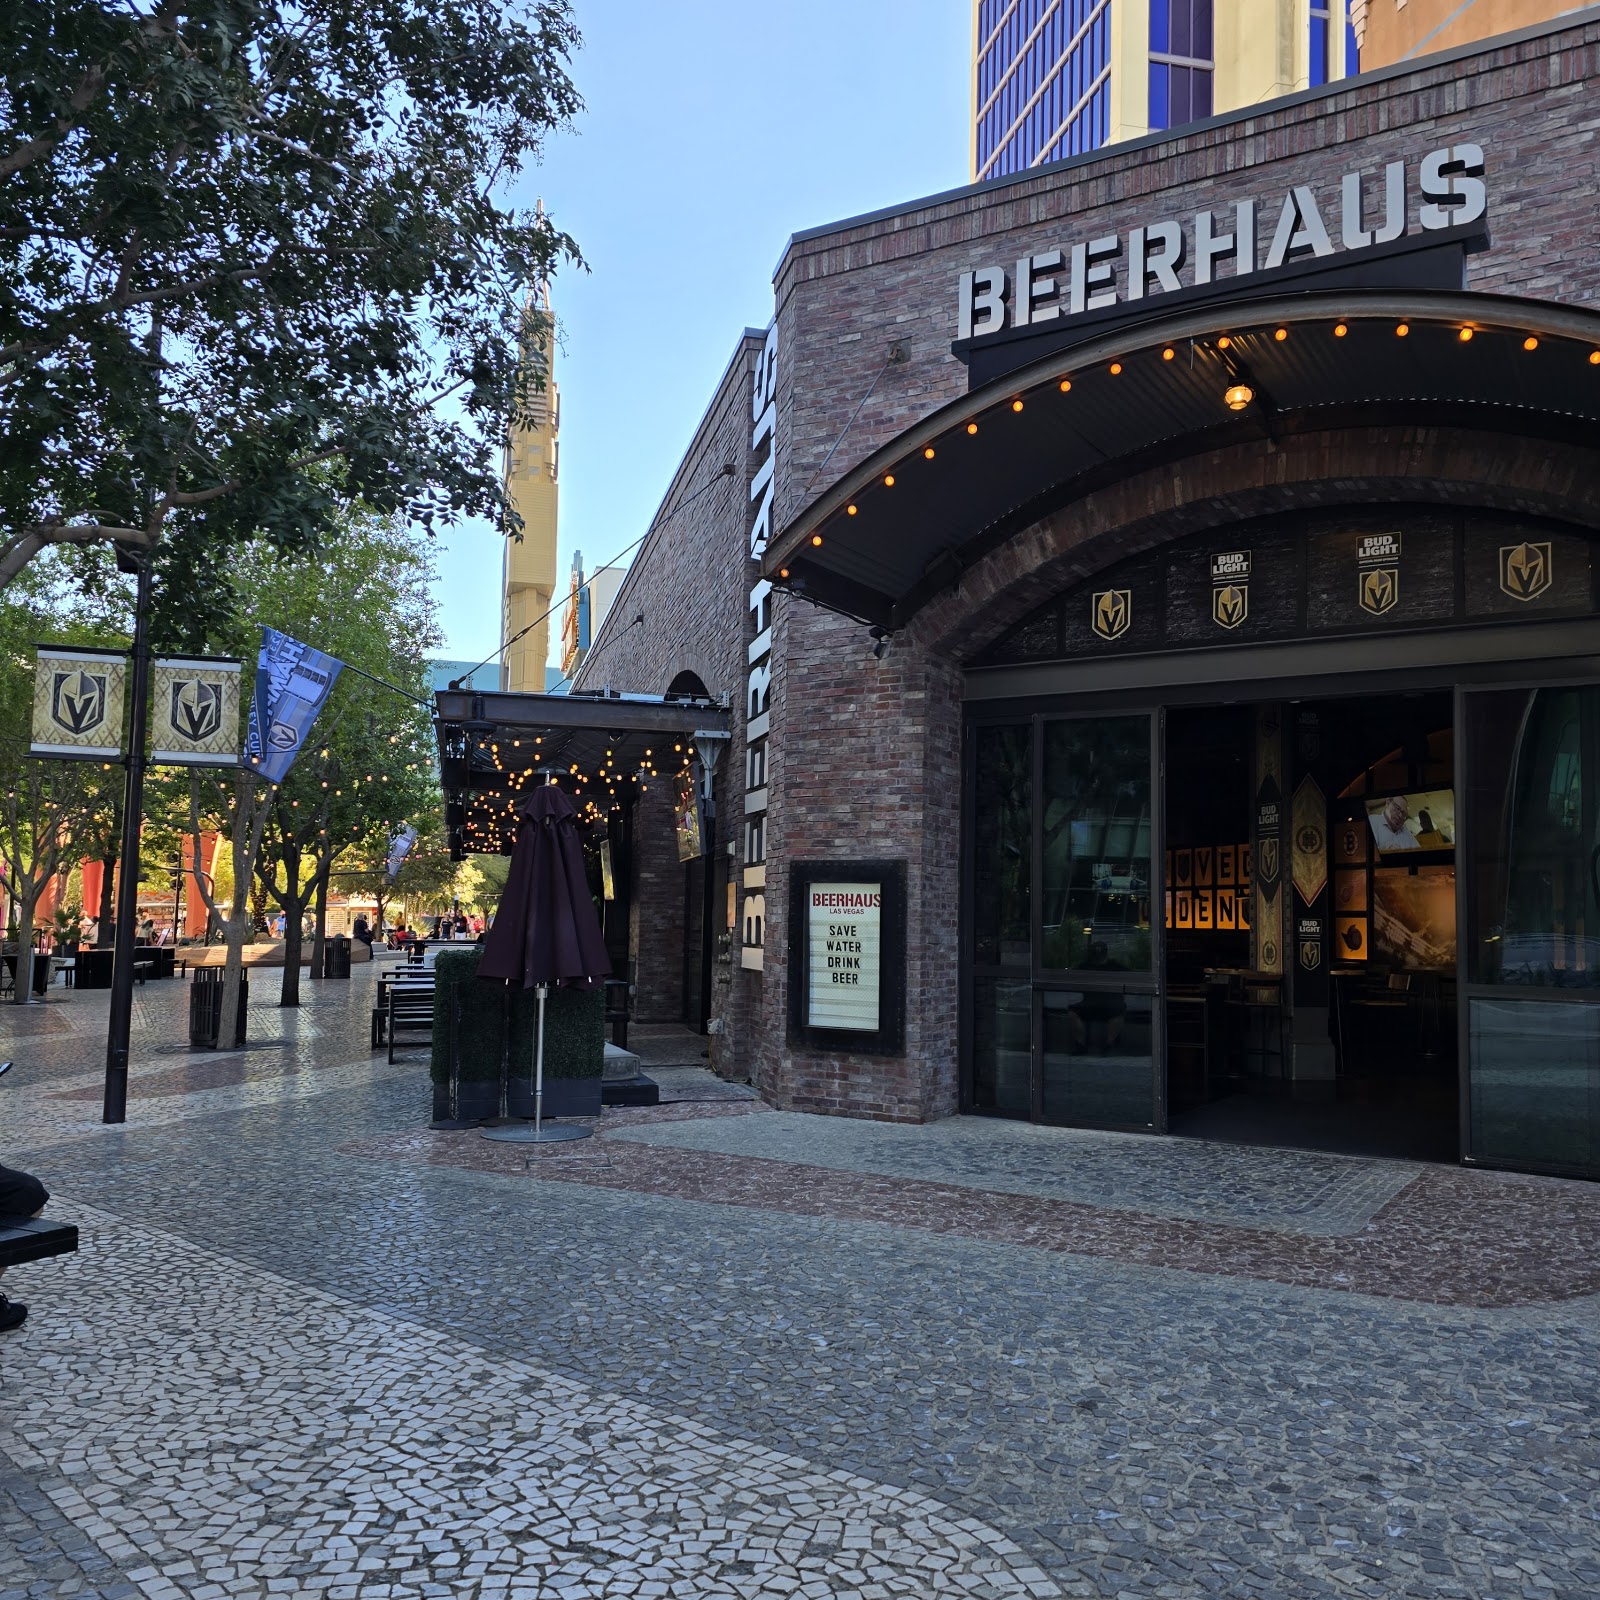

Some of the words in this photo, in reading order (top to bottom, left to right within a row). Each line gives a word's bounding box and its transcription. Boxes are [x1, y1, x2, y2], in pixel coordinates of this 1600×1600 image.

[957, 143, 1487, 340] BEERHAUS
[1364, 535, 1393, 548] BUD
[1359, 543, 1399, 557] LIGHT
[1217, 553, 1244, 565] BUD
[1212, 562, 1249, 574] LIGHT
[741, 322, 779, 971] BEERHAUS
[1261, 805, 1276, 815] BUD
[1259, 814, 1279, 824] LIGHT
[812, 893, 881, 908] BEERHAUS
[1166, 896, 1233, 922] DEN
[829, 925, 857, 937] SAVE
[826, 941, 862, 953] WATER
[827, 957, 860, 969] DRINK
[832, 972, 859, 984] BEER
